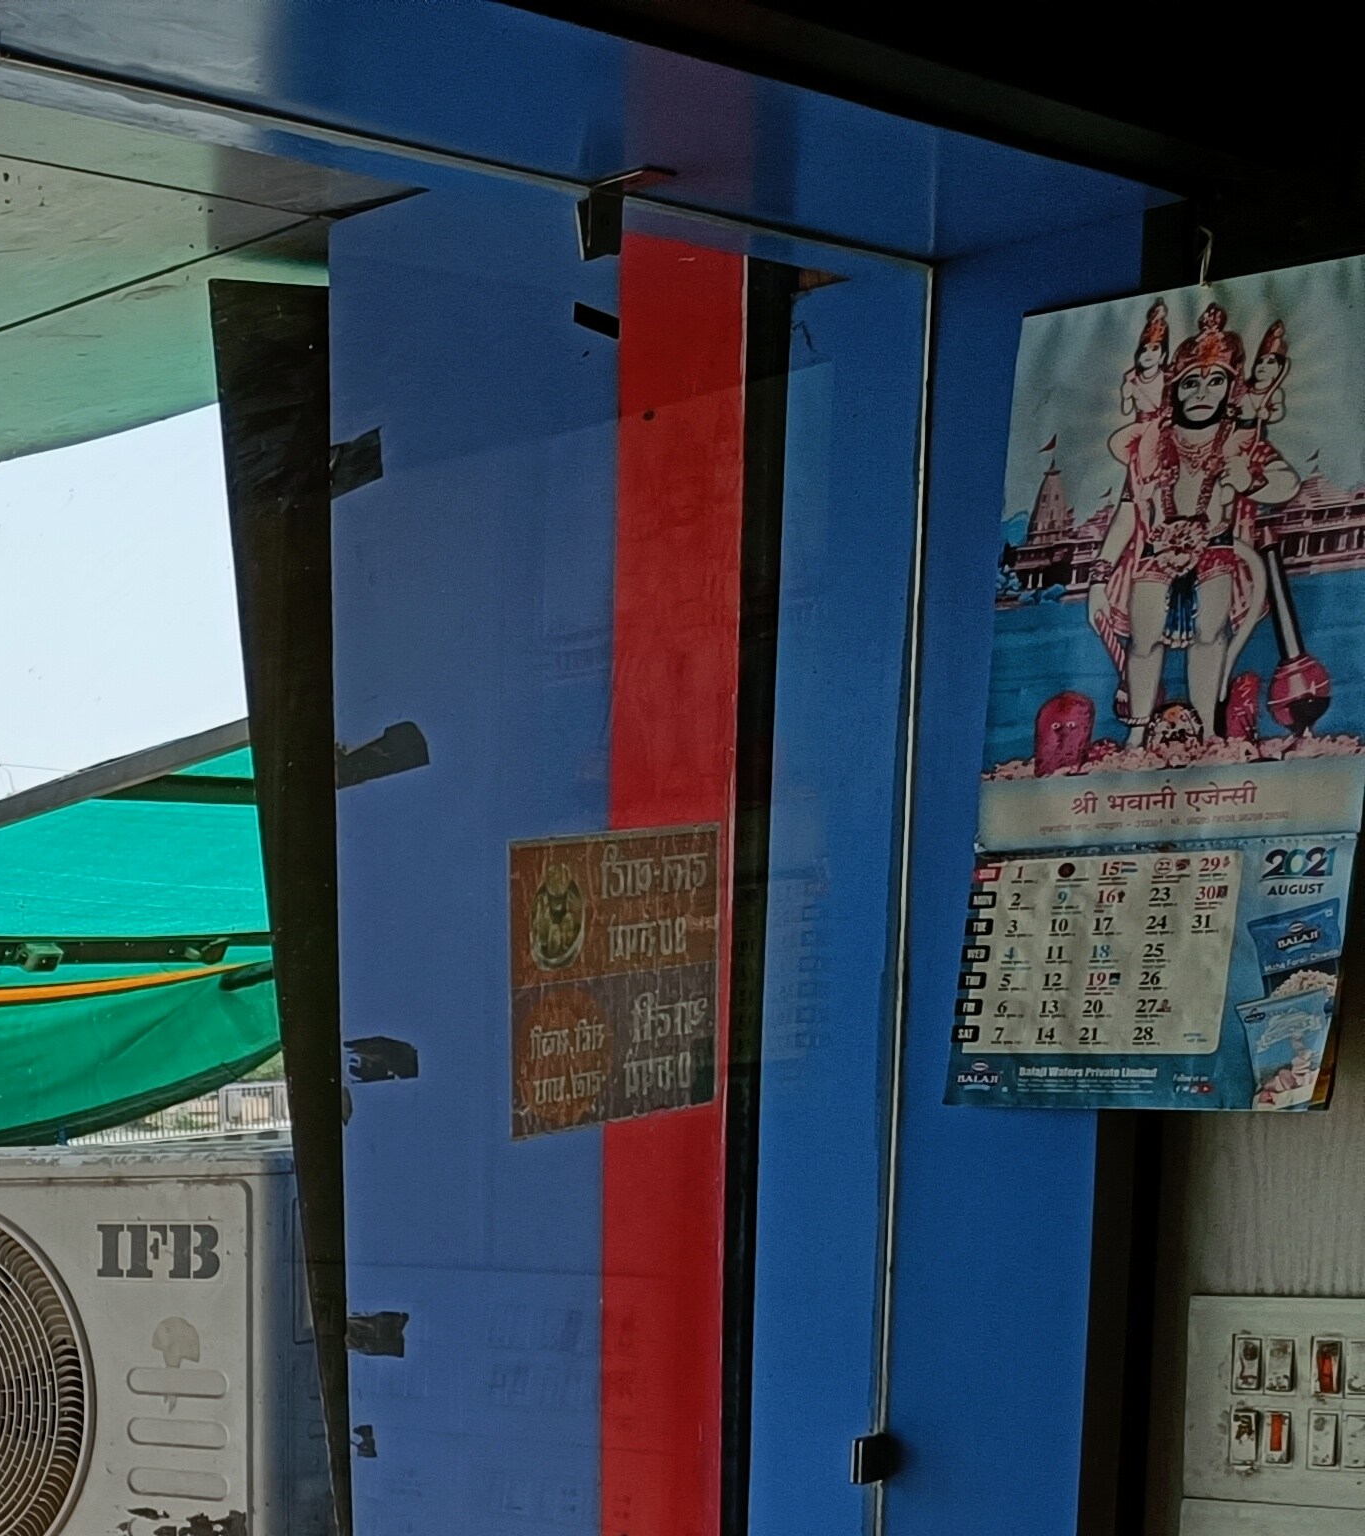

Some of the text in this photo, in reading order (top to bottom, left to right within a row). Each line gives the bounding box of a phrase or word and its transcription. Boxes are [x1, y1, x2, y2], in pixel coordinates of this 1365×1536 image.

[1071, 790, 1098, 815] श्री
[1185, 780, 1258, 812] एजेन्सी
[1017, 866, 1023, 879] 1
[1101, 861, 1120, 876] 15
[1199, 857, 1220, 872] 29
[1261, 847, 1337, 878] 2021
[1011, 886, 1216, 906] 2 9 16 23 30
[1267, 882, 1325, 896] AUGUST
[1007, 914, 1211, 933] 3 10 17 24 31
[1004, 943, 1165, 960] 4 11 18 25
[1000, 971, 1160, 987] 5 12 19 26
[997, 999, 1158, 1014] 6 13 20 27
[957, 1029, 973, 1039] SAT
[994, 1027, 1153, 1041] 7 14 21 28
[957, 1074, 999, 1084] BALAJI
[97, 1222, 221, 1279] IFB
